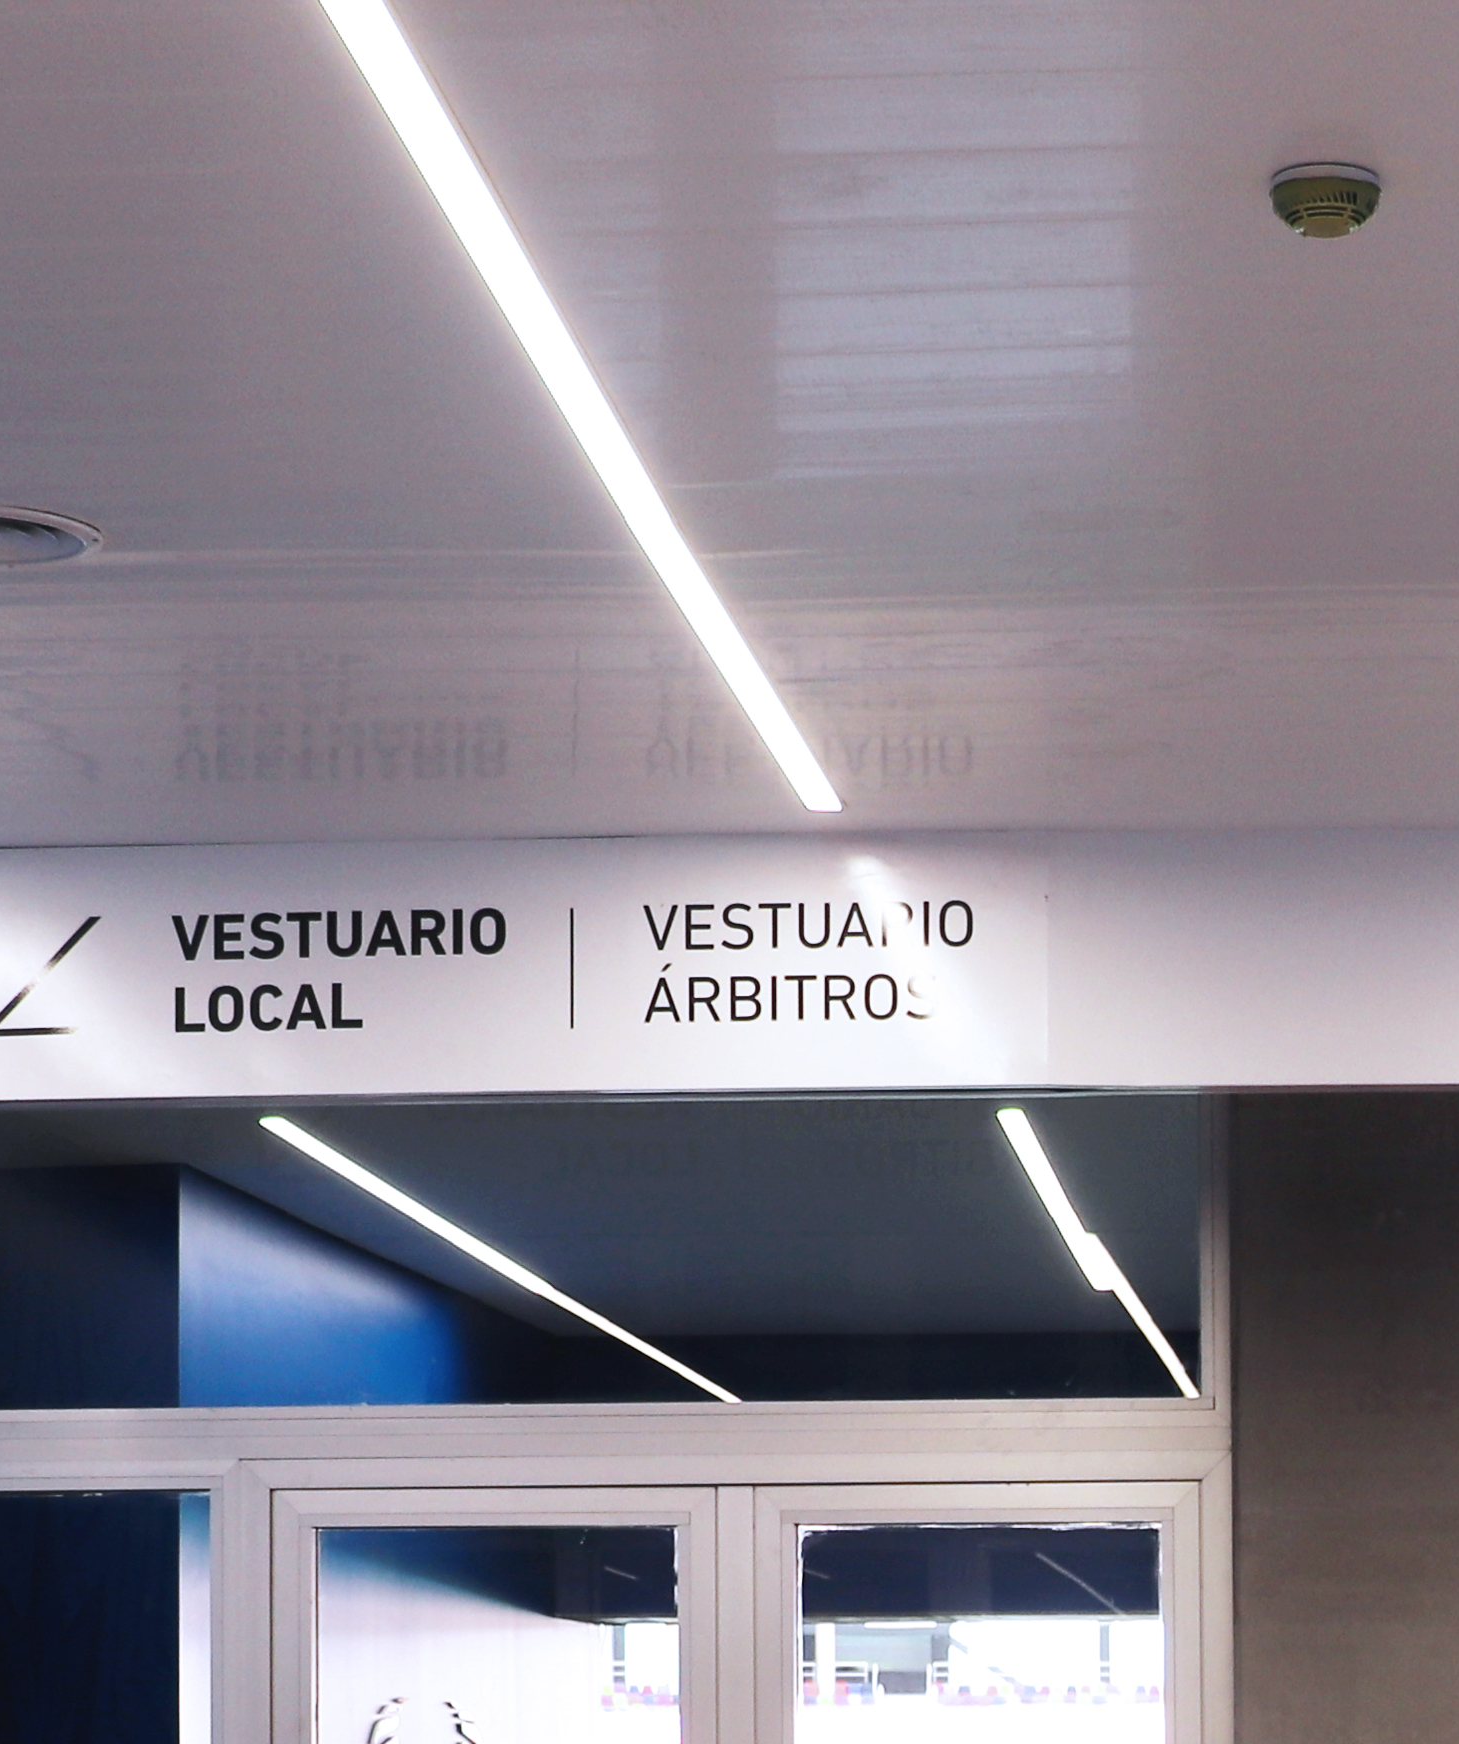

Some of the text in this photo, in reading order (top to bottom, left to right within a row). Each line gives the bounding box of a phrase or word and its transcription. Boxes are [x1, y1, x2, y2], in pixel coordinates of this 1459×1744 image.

[170, 906, 508, 962] VESTUARIO
[173, 982, 364, 1033] LOCAL
[643, 962, 937, 1024] ÁRBITROS
